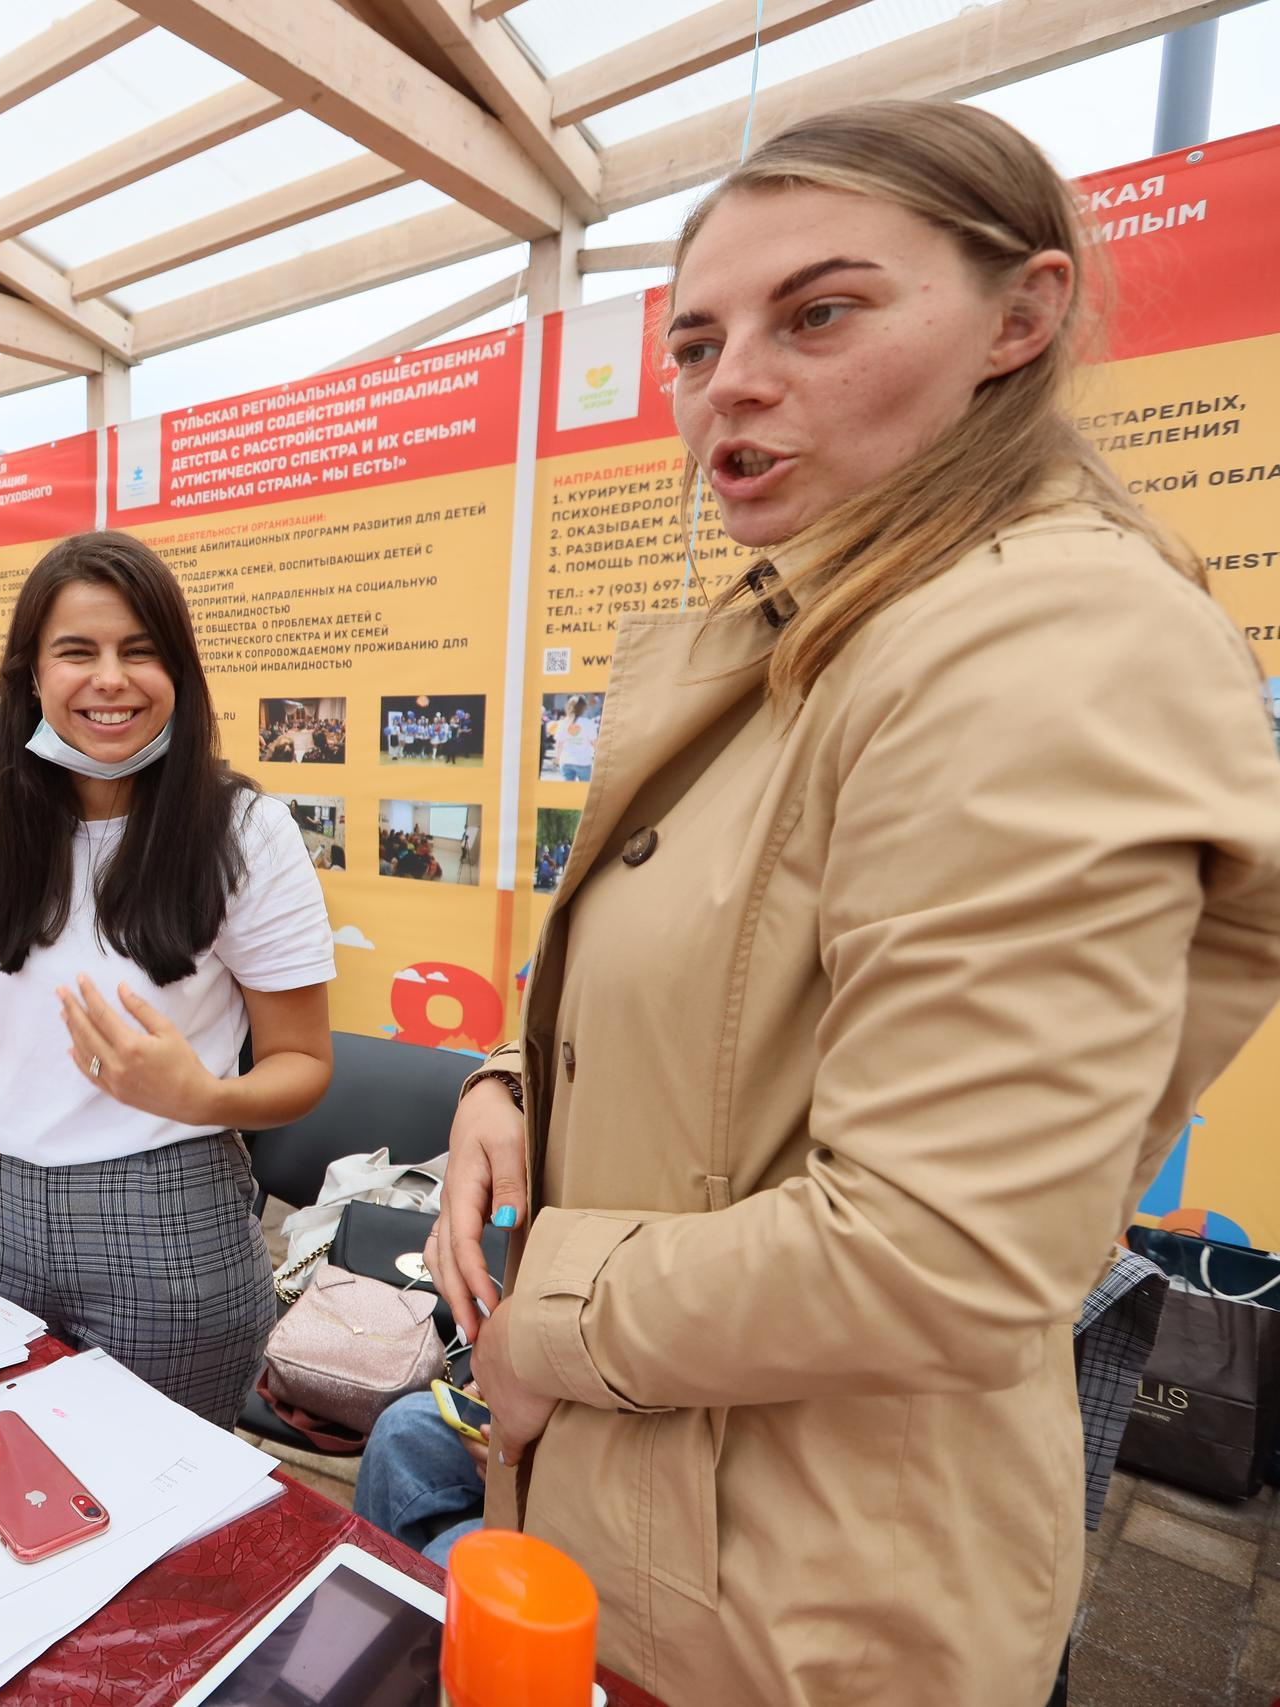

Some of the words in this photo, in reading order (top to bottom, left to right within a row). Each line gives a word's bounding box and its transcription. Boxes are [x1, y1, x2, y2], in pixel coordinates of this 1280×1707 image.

[172, 406, 238, 433] ТУЛЬСКАЯ
[242, 377, 356, 417] РЕГИОНАЛЬНАЯ
[360, 341, 506, 388] ОБЩЕСТВЕННАЯ
[172, 420, 263, 452] ОРГАНИЗАЦИЯ
[267, 396, 366, 431] СОДЕЙСТВИЯ
[370, 371, 479, 409] ИНВАЛИДАМ
[171, 449, 228, 472] ДЕТСТВА
[231, 445, 240, 459] С
[243, 416, 377, 456] РАССТРОЙСТВАМИ
[171, 456, 287, 490] АУТИСТИЧЕСКОГО
[290, 442, 358, 467] СПЕКТРА
[362, 439, 373, 453] И
[377, 433, 399, 450] ИХ
[403, 418, 476, 445] СЕМЬЯМ
[170, 483, 254, 507] «МАЛЕНЬКАЯ
[257, 472, 318, 493] СТРАНА-
[322, 465, 348, 482] МЫ
[352, 456, 406, 477] ЕСТЬ!»
[553, 460, 667, 487] НАПРАВЛЕНИЯ
[1127, 470, 1199, 494] СКОЙ
[553, 495, 563, 504] 1.
[568, 482, 650, 503] КУРИРУЕМ
[655, 478, 673, 490] 23
[177, 525, 248, 544] ДЕЯТЕЛЬНОСТИ
[251, 512, 326, 531] ОРГАНИЗАЦИИ:
[200, 534, 290, 553] АБИЛИТАЦИОННЫХ
[293, 525, 349, 541] ПРОГРАММ
[353, 516, 412, 532] РАЗВИТИЯ
[415, 511, 441, 524] ДЛЯ
[444, 502, 487, 520] ДЕТЕЙ
[550, 529, 562, 540] 2.
[567, 517, 663, 538] ОКАЗЫВАЕМ
[549, 547, 561, 557] 3.
[566, 535, 657, 555] РАЗВИВАЕМ
[181, 568, 239, 582] ПОДДЕРЖКА
[240, 562, 277, 576] СЕМЕЙ,
[279, 550, 380, 571] ВОСПИТЫВАЮЩИХ
[383, 543, 422, 559] ДЕТЕЙ
[425, 544, 434, 554] С
[548, 564, 561, 573] 4.
[566, 558, 633, 573] ПОМОЩЬ
[187, 582, 234, 594] РАЗВИТИЯ
[251, 585, 335, 601] НАПРАВЛЕННЫХ
[338, 584, 353, 595] НА
[355, 575, 438, 592] СОЦИАЛЬНУЮ
[548, 587, 584, 600] ТЕЛ.:
[588, 585, 604, 597] +7
[609, 582, 647, 597] (903)
[197, 611, 203, 620] С
[205, 604, 291, 619] ИНВАЛИДНОСТЬЮ
[547, 605, 582, 617] ТЕЛ.:
[587, 604, 602, 614] +7
[607, 599, 645, 615] (953)
[206, 621, 257, 633] ОБЩЕСТВА
[262, 620, 269, 630] О
[271, 616, 333, 628] ПРОБЛЕМАХ
[336, 610, 371, 624] ДЕТЕЙ
[375, 611, 382, 621] С
[546, 621, 602, 634] E-MAIL:
[275, 632, 321, 643] СПЕКТРА
[324, 632, 331, 640] И
[334, 629, 348, 639] ИХ
[351, 624, 389, 637] СЕМЕЙ
[236, 651, 242, 660] К
[244, 644, 351, 658] СОПРОВОЖДАЕМОМУ
[354, 639, 439, 653] ПРОЖИВАНИЮ
[442, 637, 468, 649] ДЛЯ
[260, 659, 352, 672] ИНВАЛИДНОСТЬЮ
